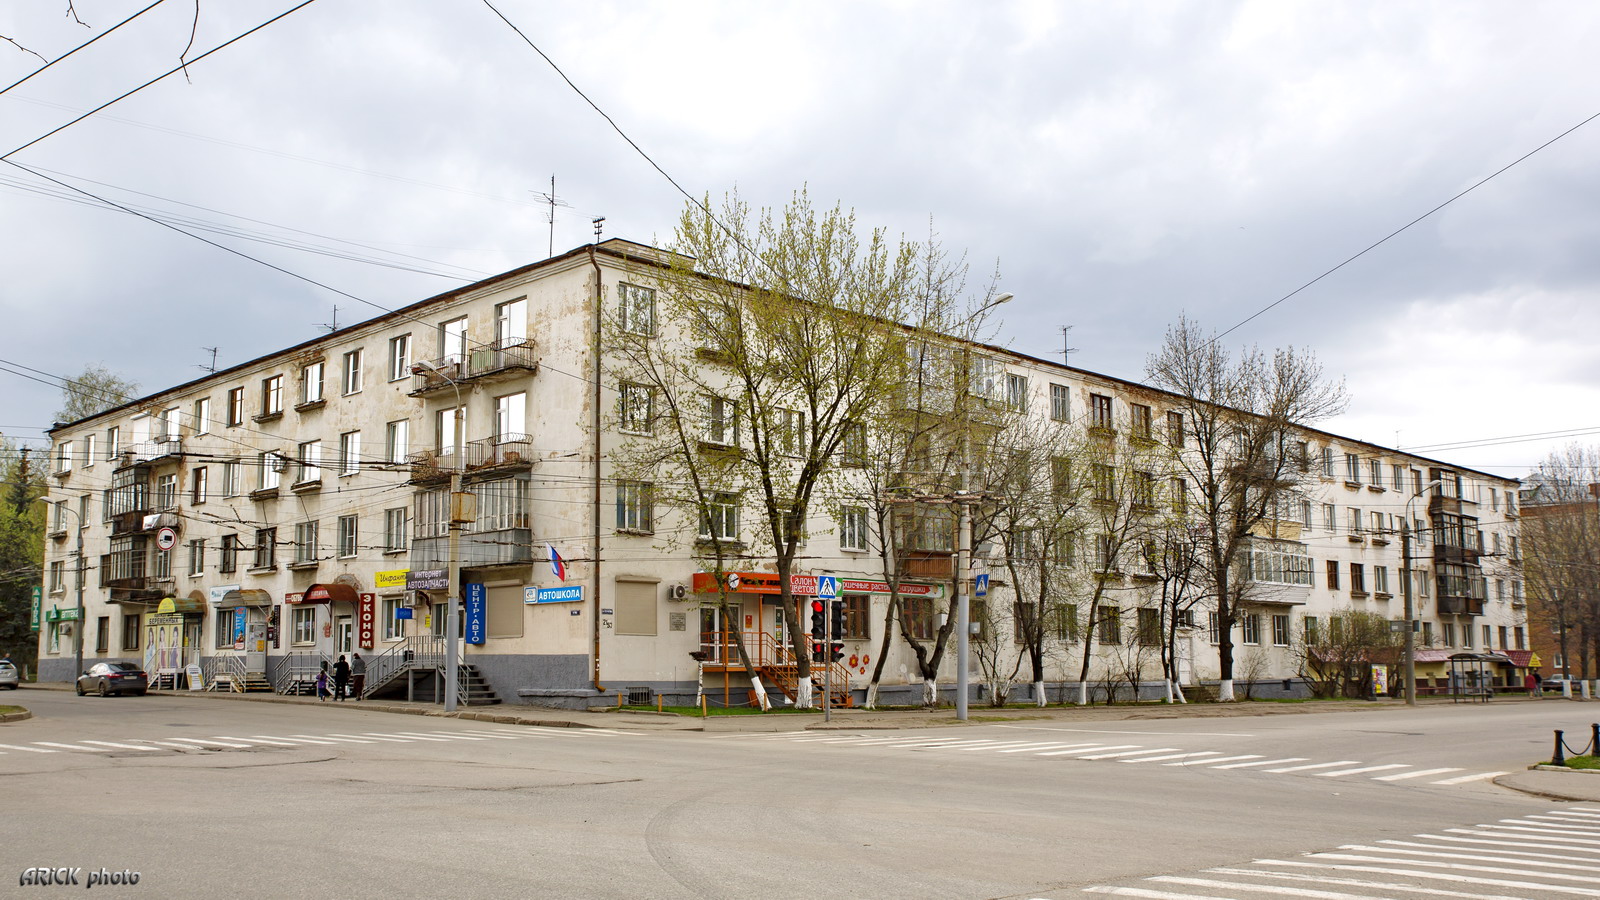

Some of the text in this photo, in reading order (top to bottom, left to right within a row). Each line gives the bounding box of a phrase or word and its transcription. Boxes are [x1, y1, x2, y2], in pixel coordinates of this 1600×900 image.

[790, 575, 813, 586] Салон
[538, 589, 581, 601] АВТОШКОЛА
[362, 594, 372, 647] ЭКОНОМ
